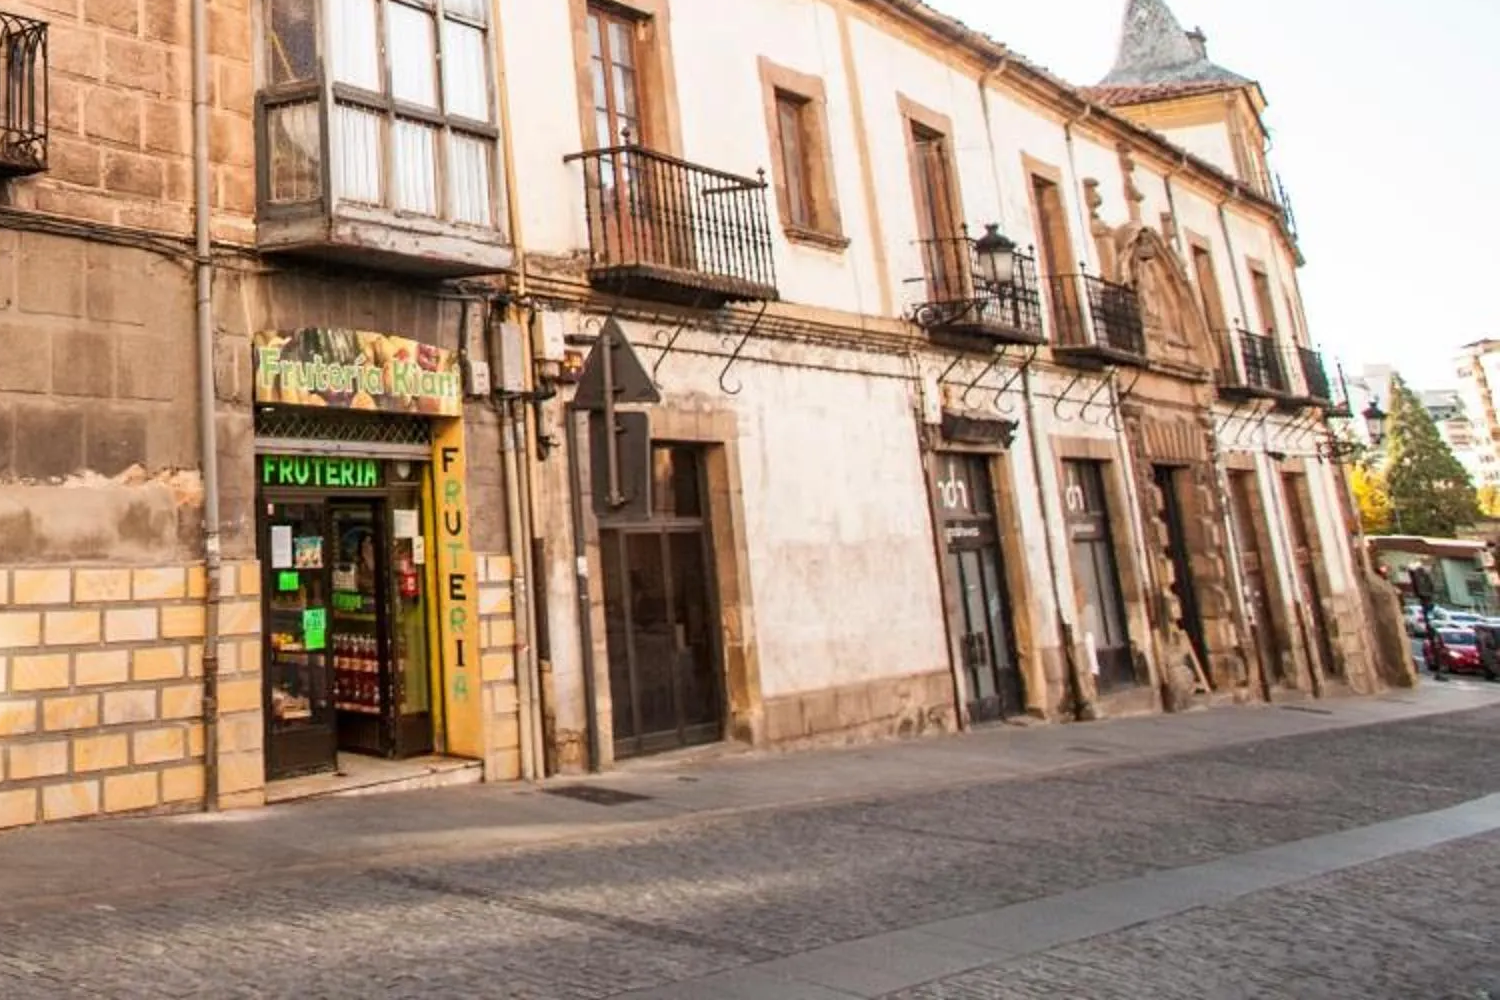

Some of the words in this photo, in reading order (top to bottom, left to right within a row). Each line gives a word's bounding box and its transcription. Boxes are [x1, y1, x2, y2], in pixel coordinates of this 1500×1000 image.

[259, 347, 385, 395] Frutería
[264, 456, 378, 487] FRUTERIA
[442, 448, 468, 698] FRUTERIA
